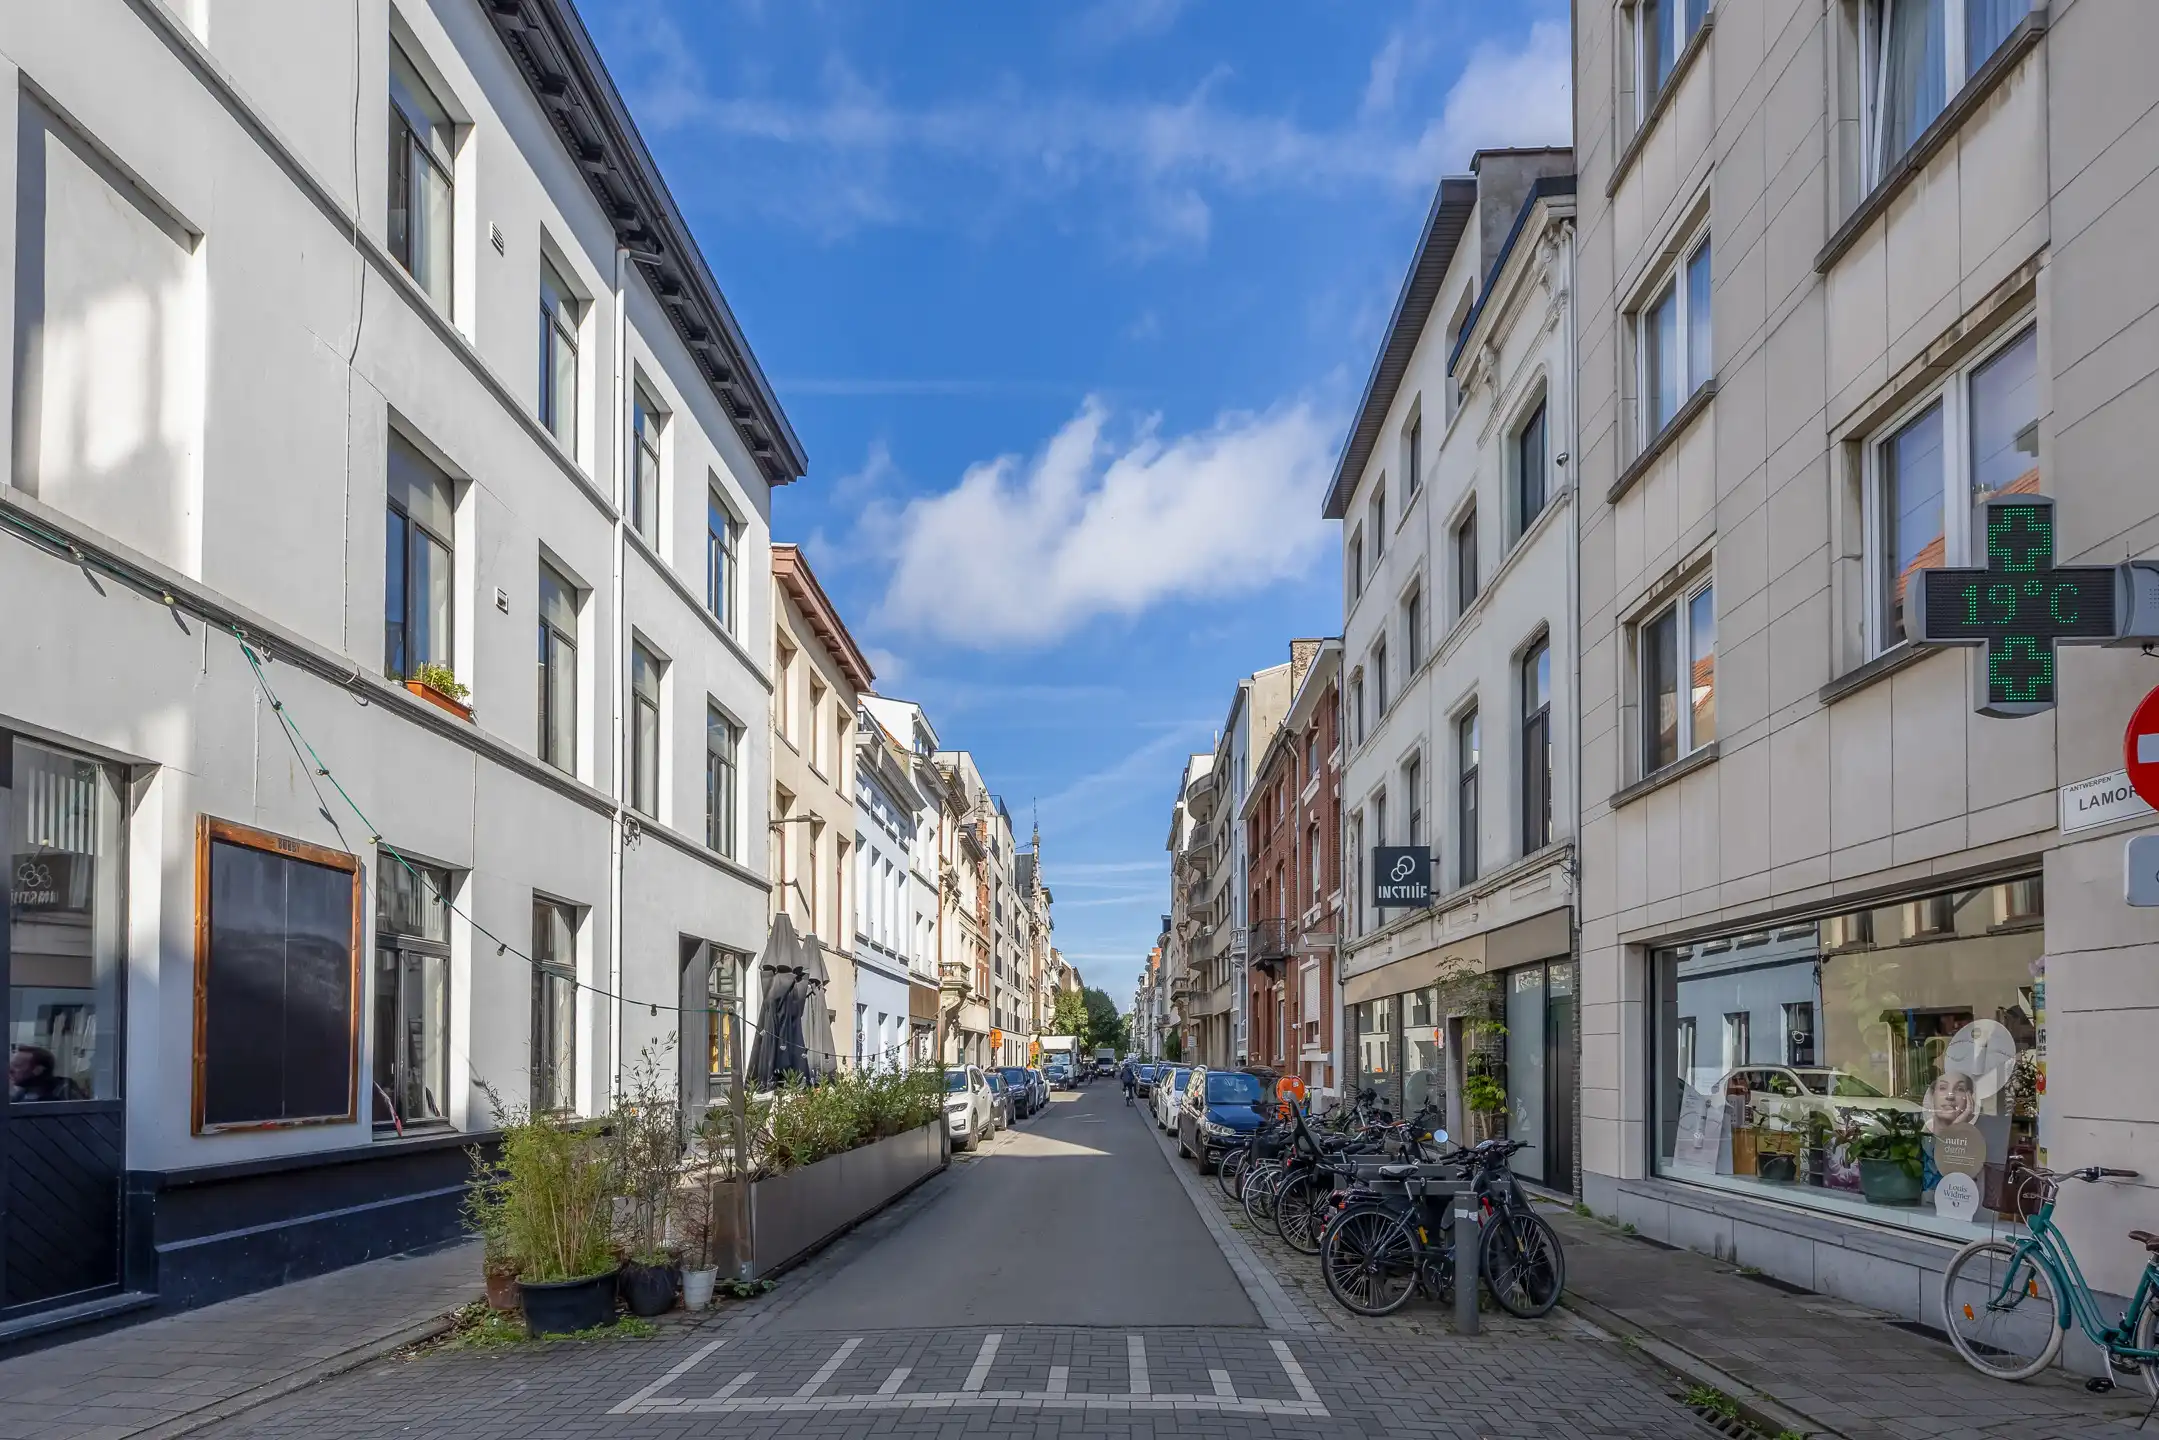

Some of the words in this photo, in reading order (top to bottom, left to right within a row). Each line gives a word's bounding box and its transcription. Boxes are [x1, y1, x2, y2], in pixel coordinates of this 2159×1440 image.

[1962, 580, 2078, 624] 19°C
[2069, 776, 2112, 792] ANTWERPEN
[1945, 1137, 1968, 1146] nutri
[1948, 1183, 1968, 1193] Louis
[1943, 1189, 1972, 1200] Widmer
